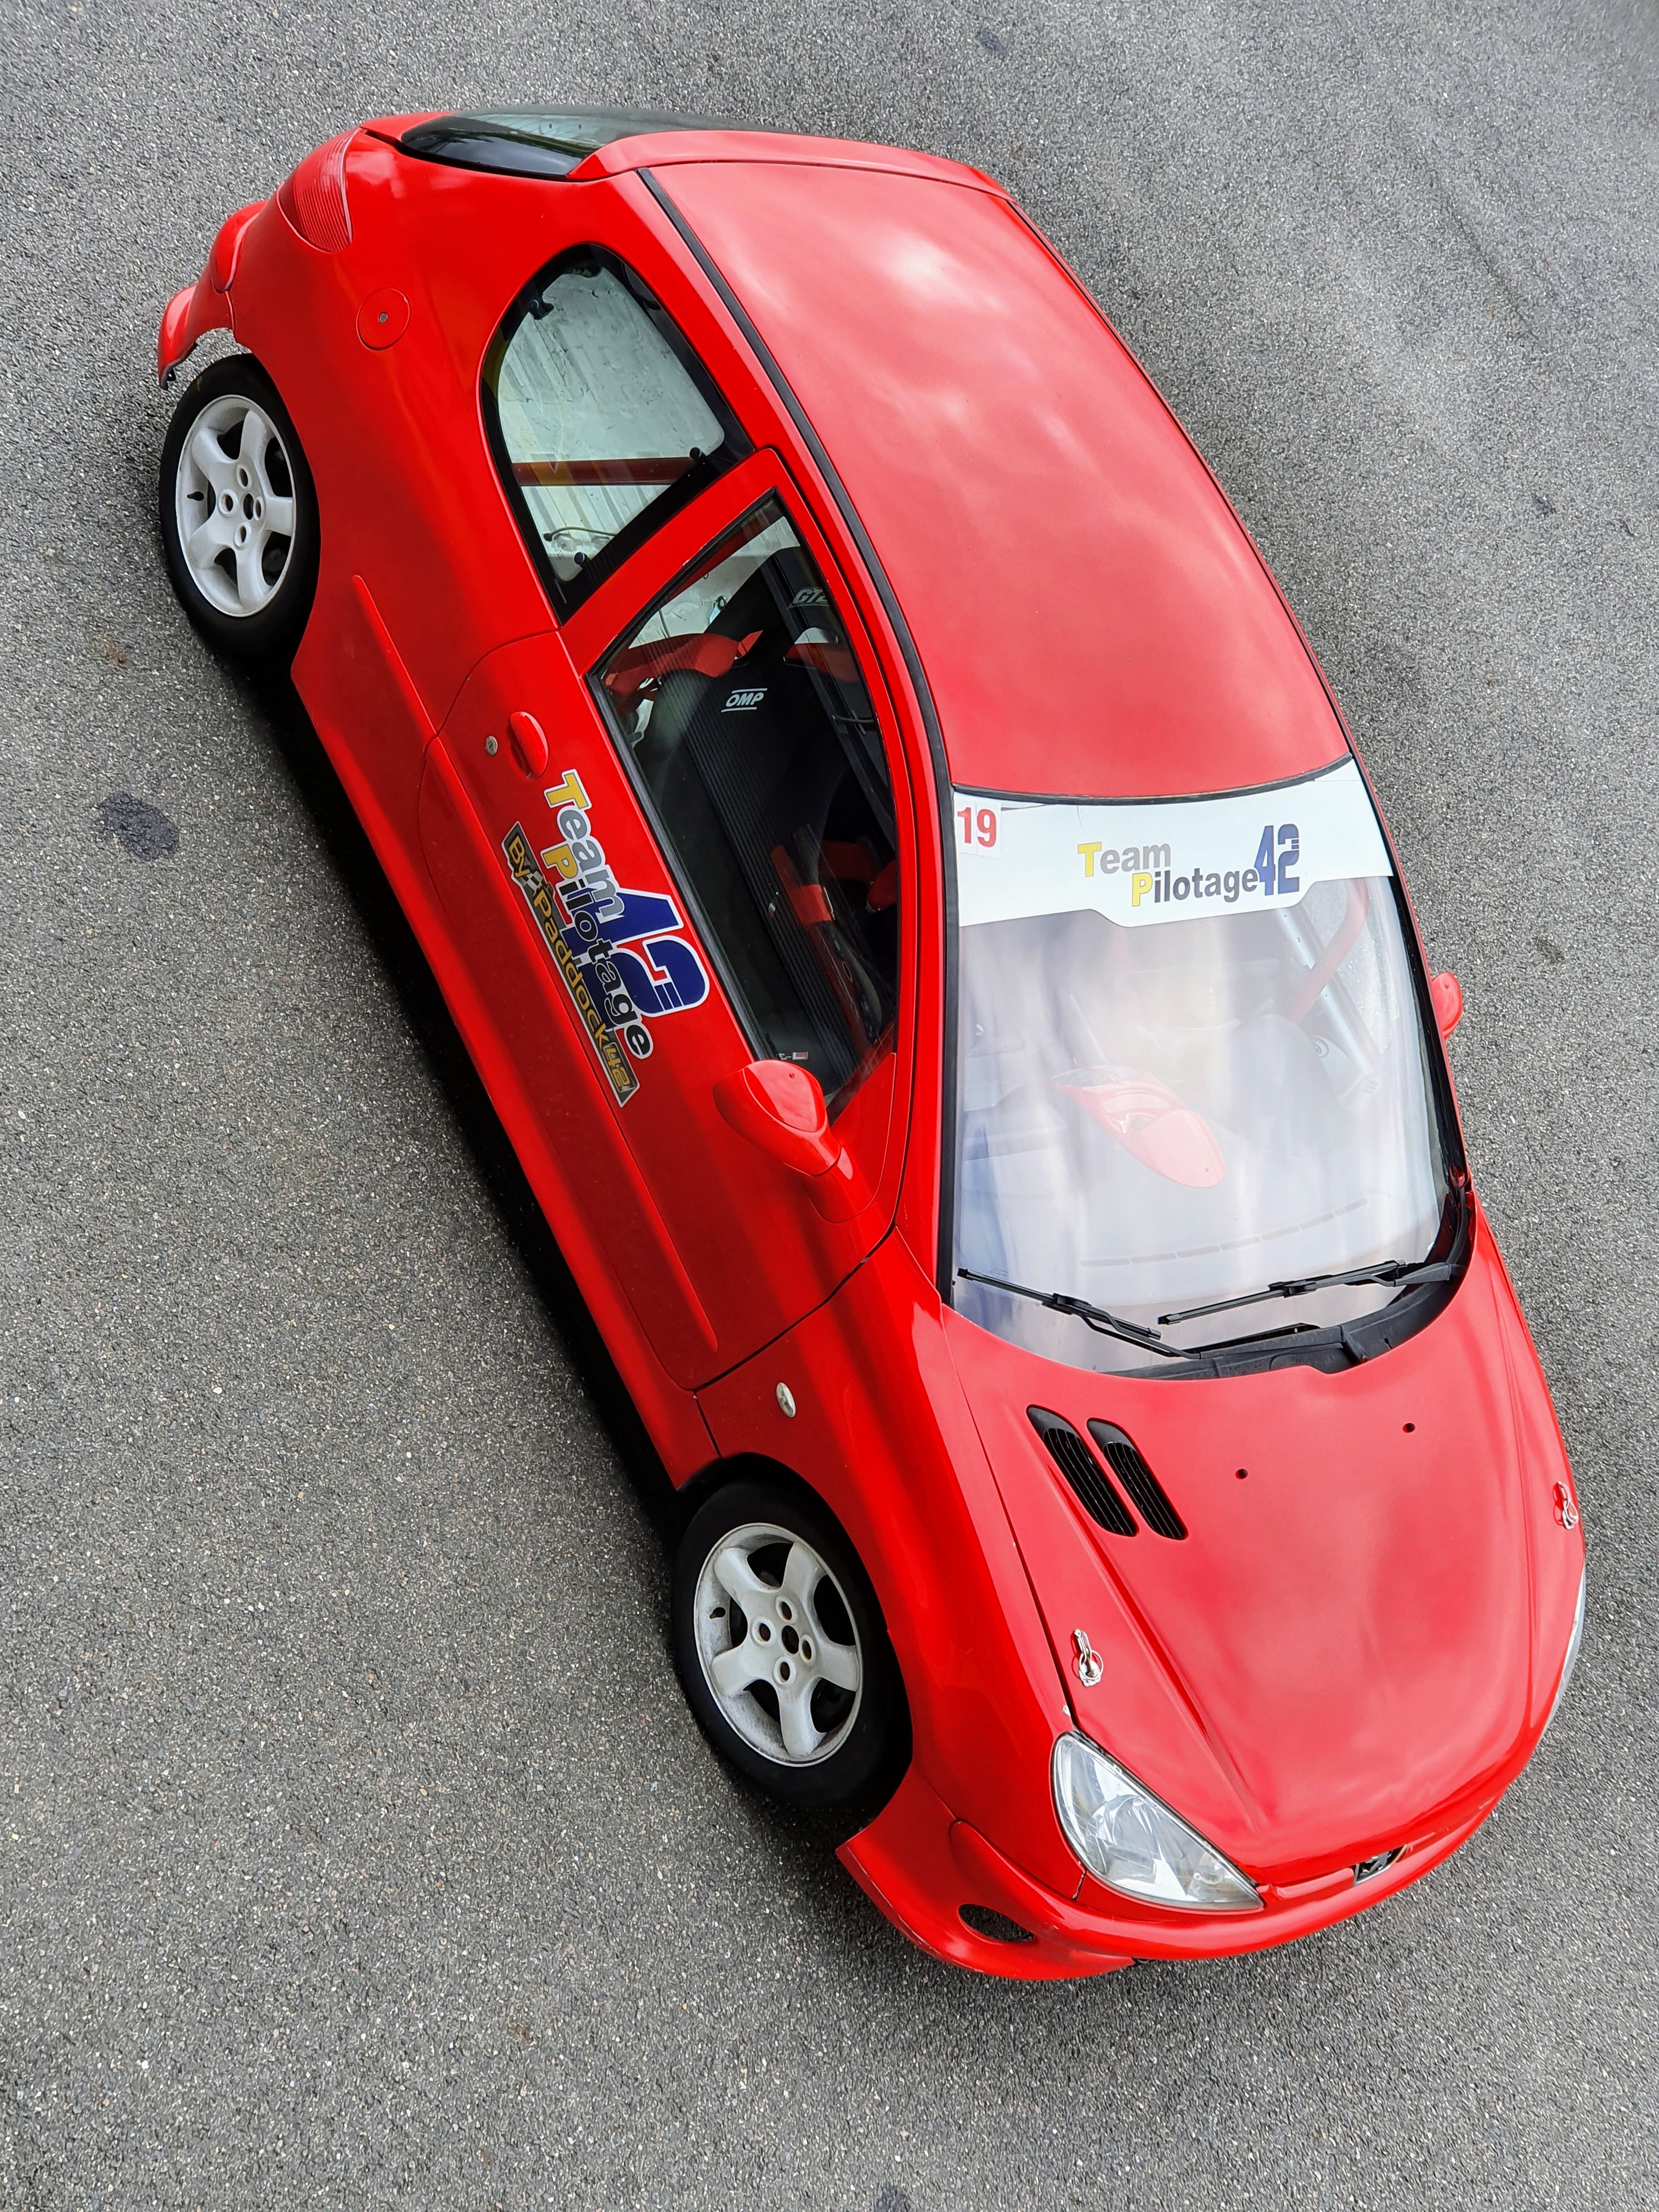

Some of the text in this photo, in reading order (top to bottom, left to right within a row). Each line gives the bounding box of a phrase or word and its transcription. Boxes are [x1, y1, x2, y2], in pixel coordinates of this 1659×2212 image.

[725, 692, 764, 707] OMP
[548, 772, 624, 918] Team
[957, 807, 997, 848] 19
[1077, 841, 1171, 878] Team
[1131, 823, 1300, 907] Pilotage 42
[509, 836, 631, 1087] By Paddock 42
[543, 844, 652, 1056] Pilotage
[562, 888, 708, 1029] 42
